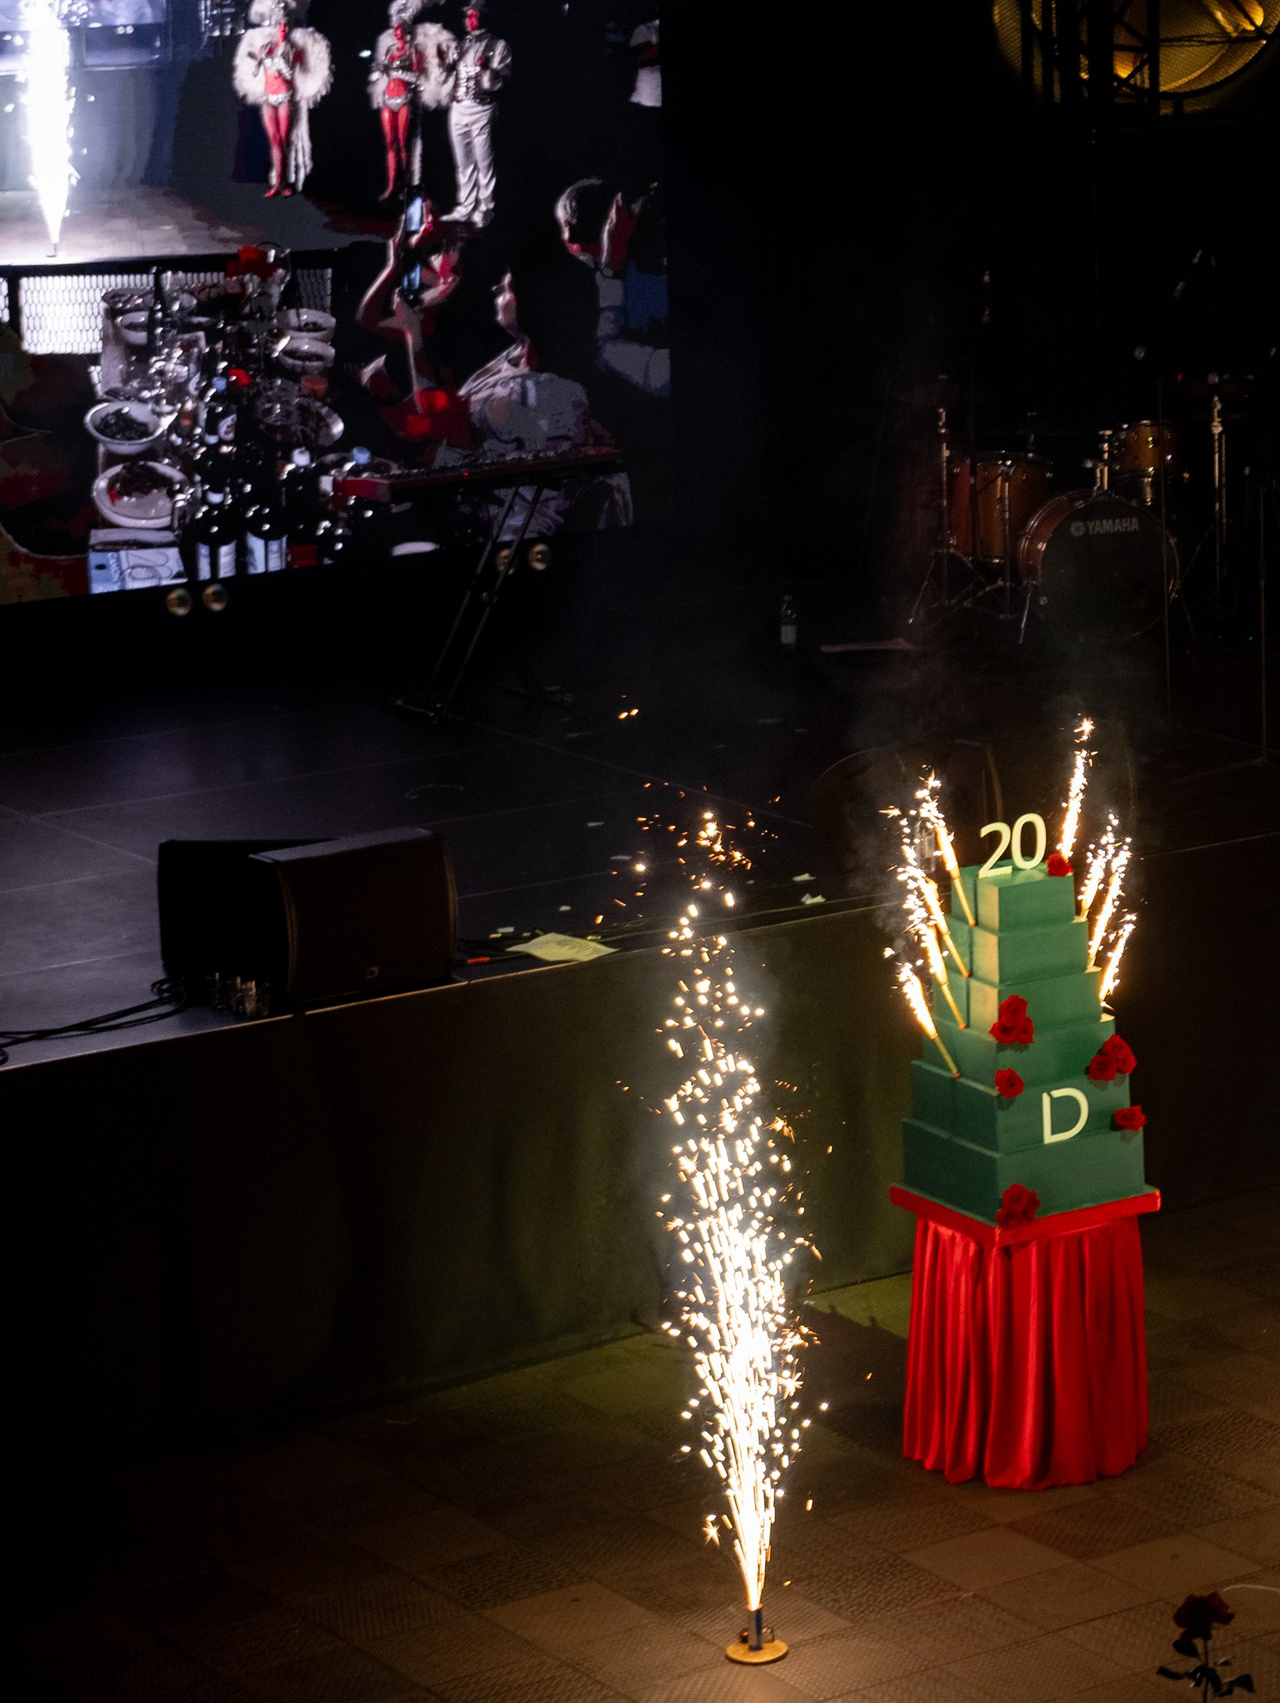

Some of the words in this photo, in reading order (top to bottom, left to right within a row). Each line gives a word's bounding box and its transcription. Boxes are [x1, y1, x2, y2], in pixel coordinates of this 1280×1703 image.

[1086, 517, 1139, 535] YAMAHA
[979, 812, 1047, 879] 20
[1042, 1087, 1089, 1145] D
